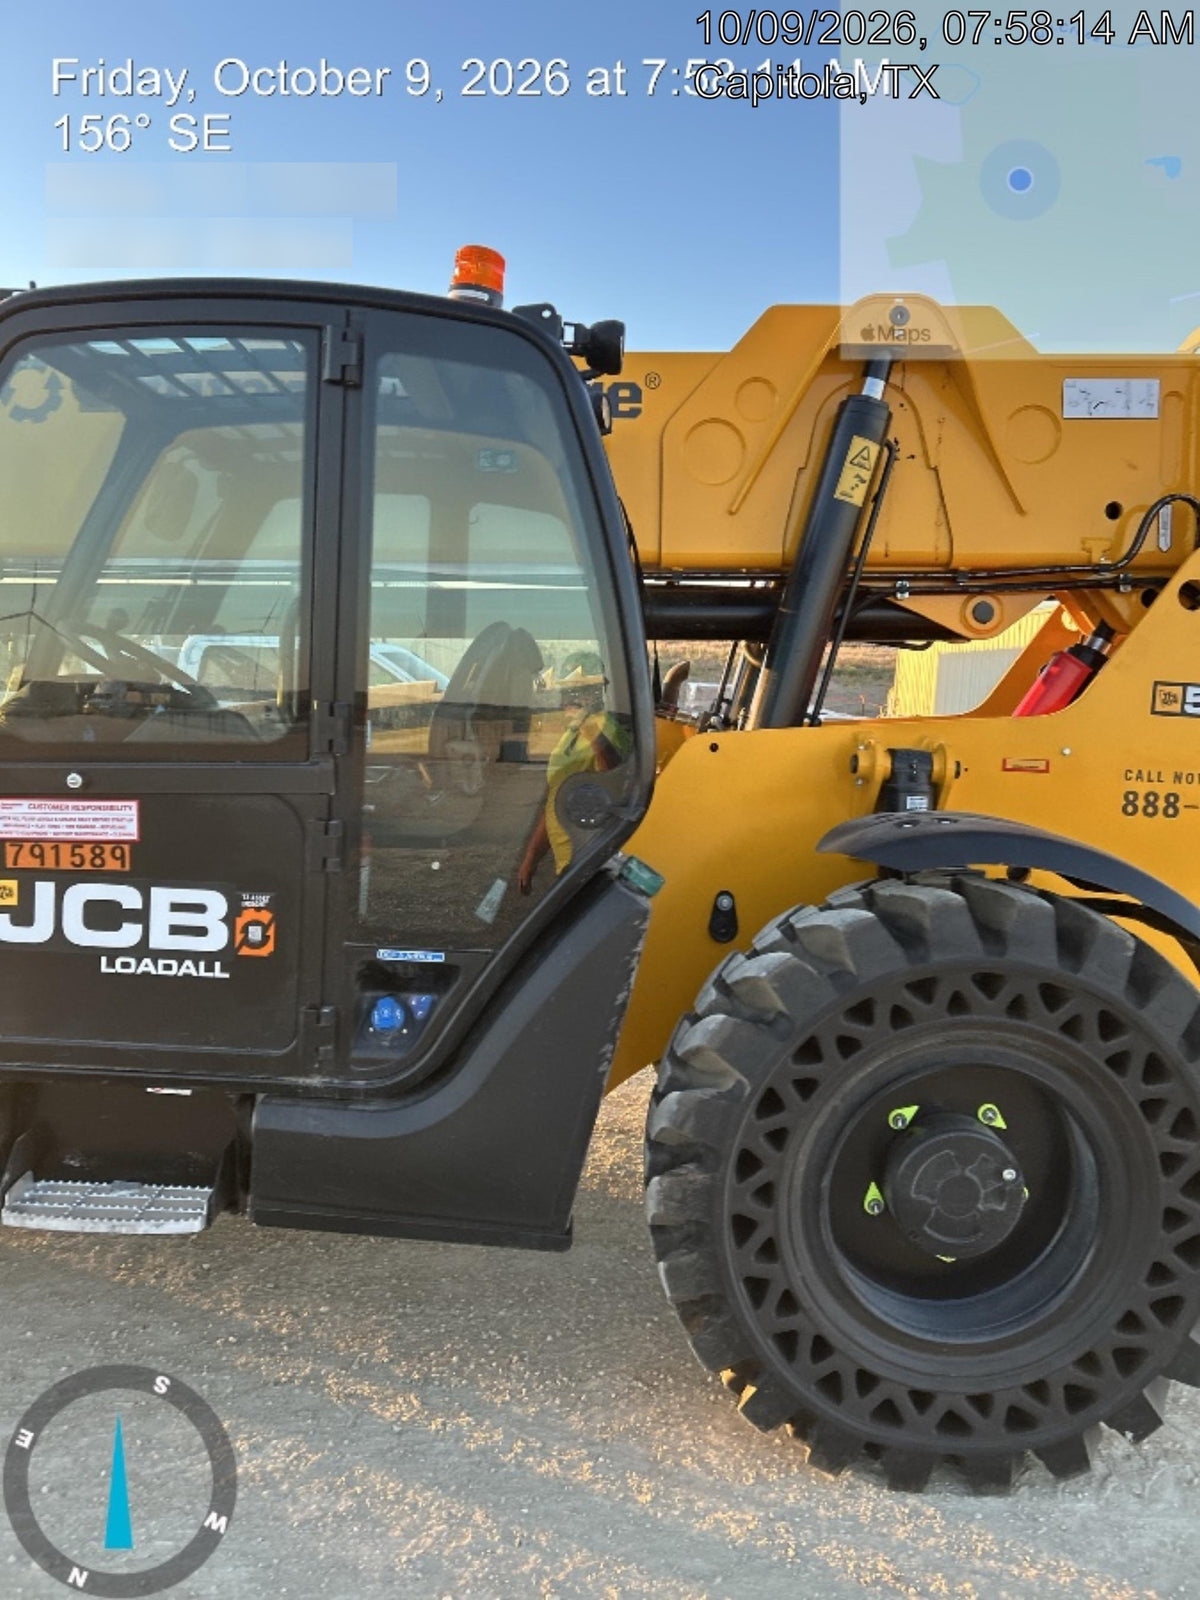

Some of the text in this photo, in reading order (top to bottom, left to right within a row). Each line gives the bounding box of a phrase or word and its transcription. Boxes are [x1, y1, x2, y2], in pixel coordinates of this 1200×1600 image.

[1124, 768, 1200, 785] CALL NO
[8, 843, 127, 869] 791589
[0, 881, 229, 952] JCB
[100, 955, 230, 979] LOADALL
